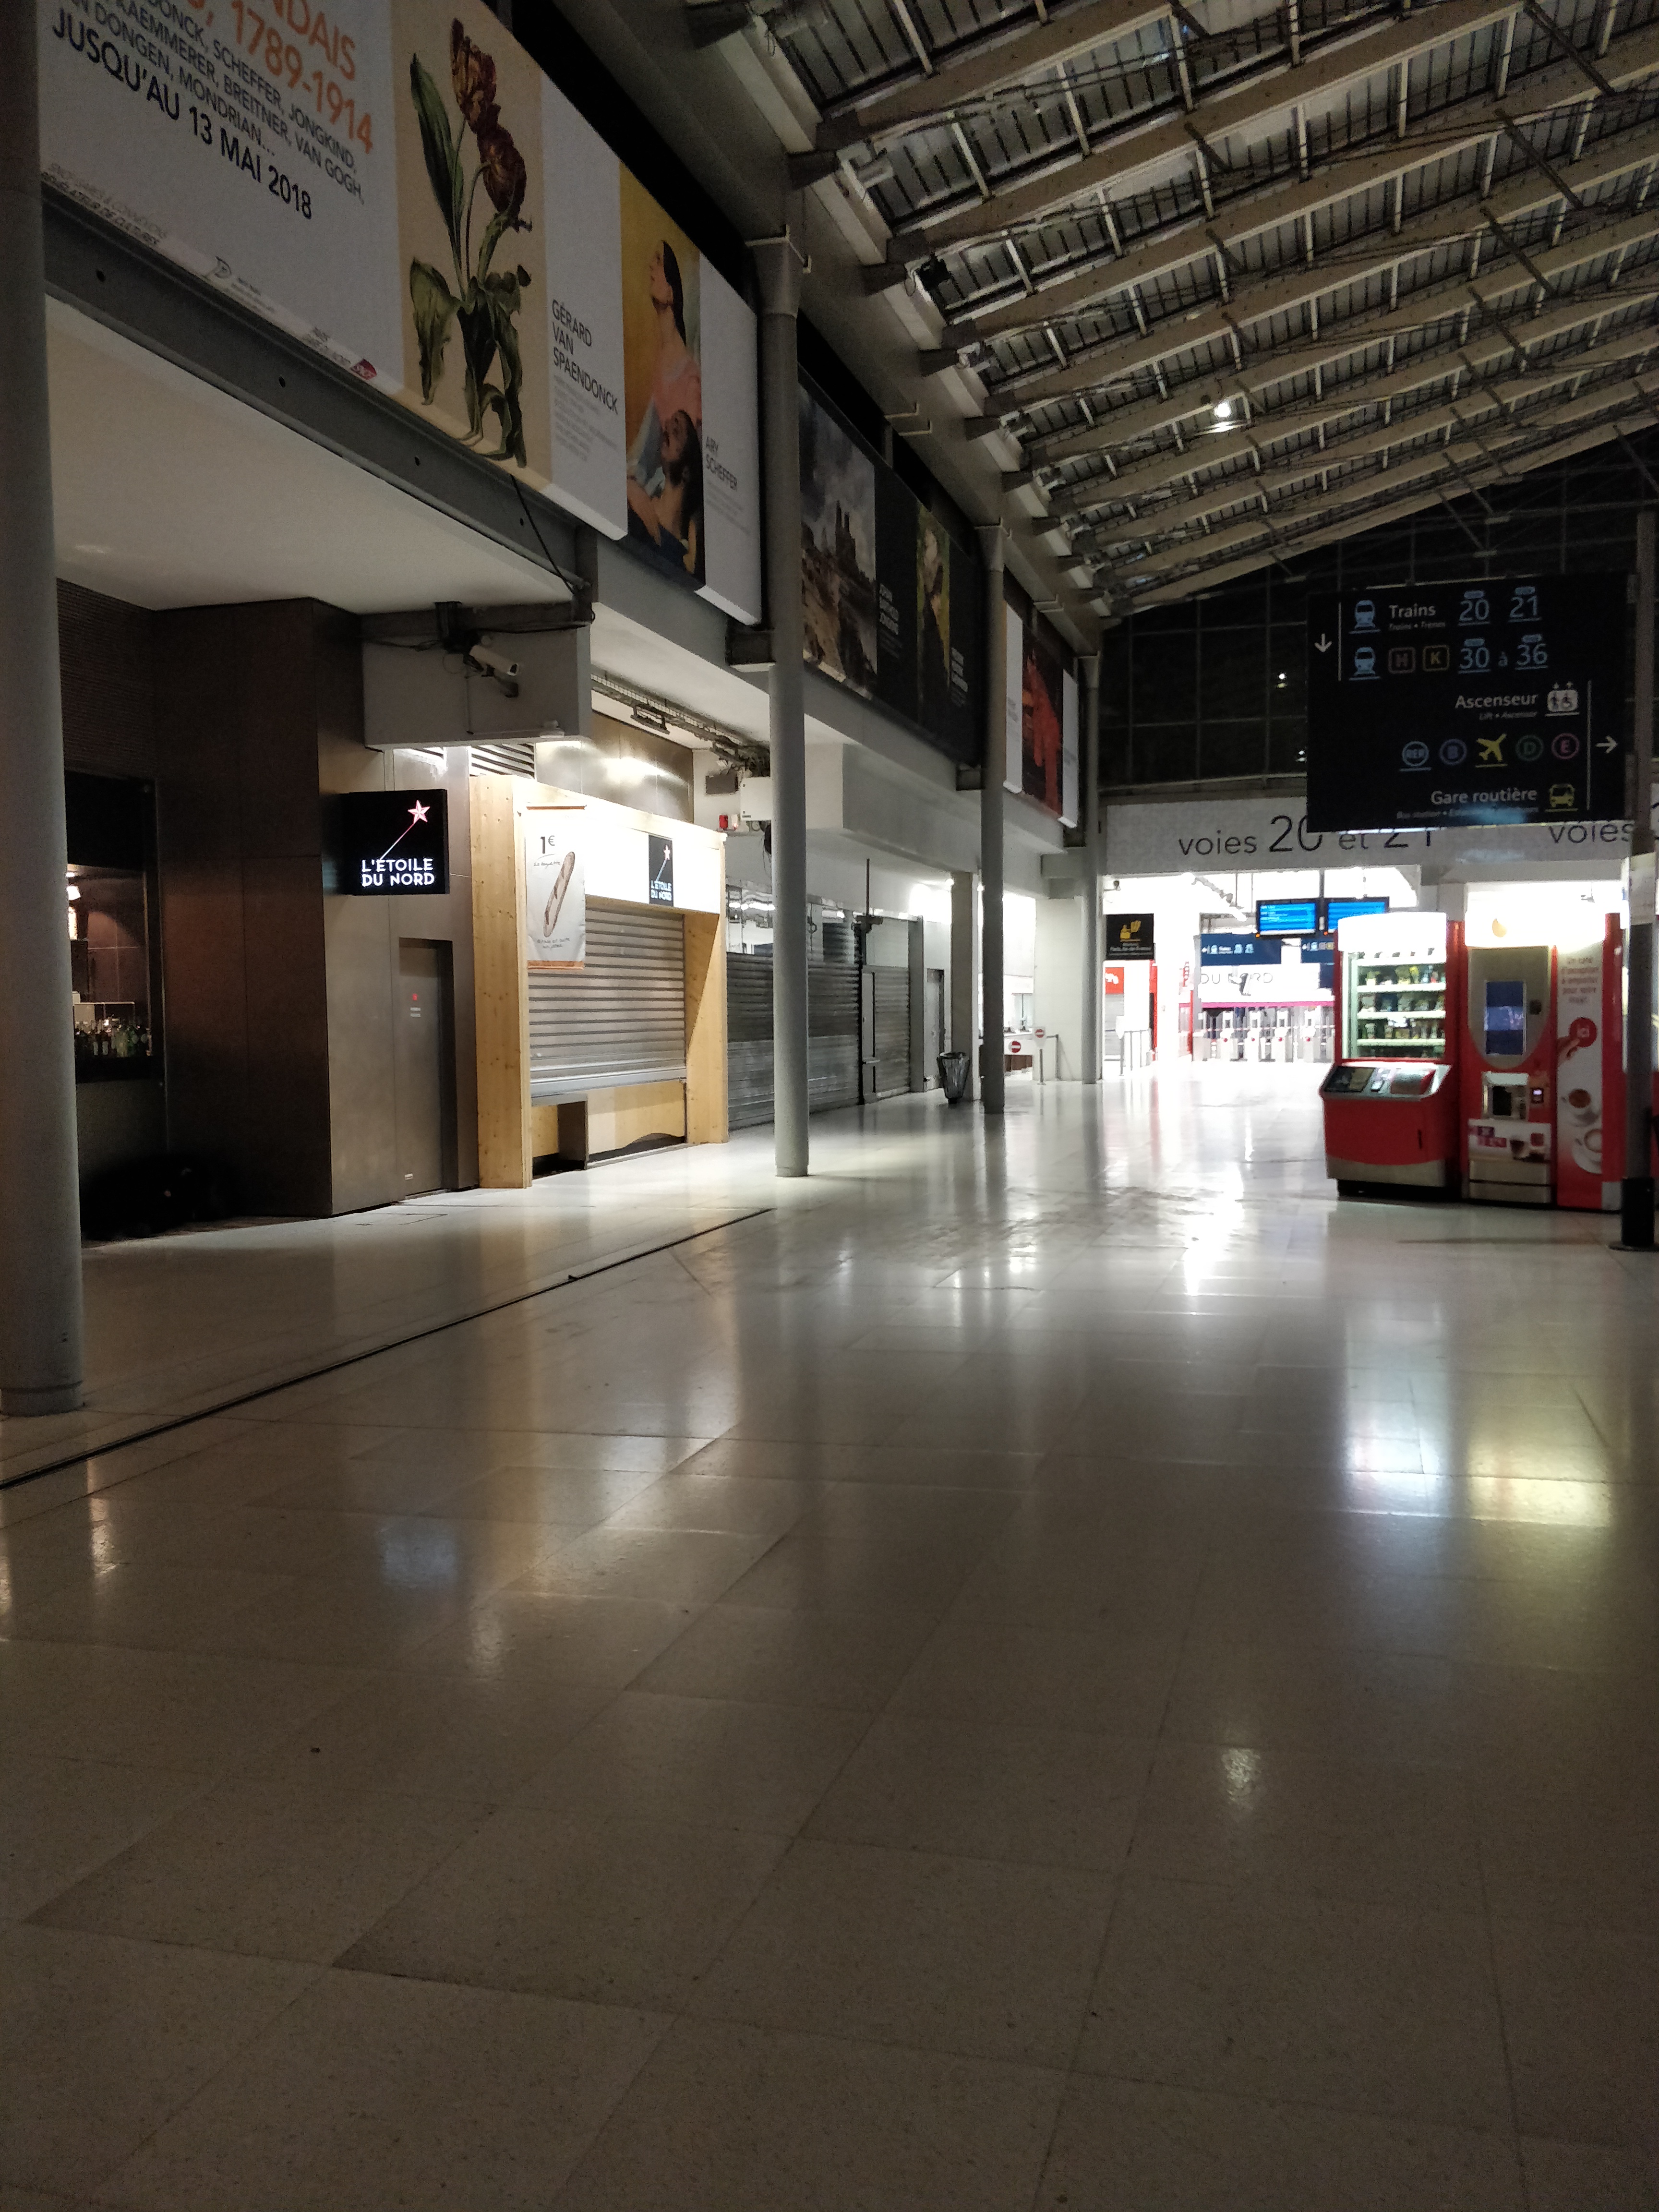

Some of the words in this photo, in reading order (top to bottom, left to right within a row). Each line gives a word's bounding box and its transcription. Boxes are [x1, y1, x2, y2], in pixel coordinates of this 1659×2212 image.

[272, 0, 356, 81] DAIS
[232, 1, 374, 155] 1789-1914
[52, 7, 180, 120] JUSQU'AU
[189, 106, 213, 145] 13
[220, 127, 261, 183] MAI
[268, 165, 312, 219] 2018
[213, 38, 284, 116] SCHEFFER,
[289, 103, 357, 175] JONGKIND,
[223, 74, 292, 146] BREITNER,
[294, 131, 322, 168] VAN
[552, 299, 592, 347] GÉRARD
[552, 321, 574, 356] VAN
[553, 346, 619, 415] SPAENDONCK
[1388, 603, 1437, 619] Trains
[1458, 599, 1490, 623] 20
[1508, 595, 1539, 619] 21
[1430, 651, 1442, 666] K
[1458, 647, 1491, 670] 30
[1498, 650, 1508, 668] à
[1516, 642, 1549, 667] 36
[1455, 694, 1539, 709] Ascenseur
[1430, 790, 1468, 805] Gare
[1472, 787, 1538, 802] routière
[1178, 830, 1257, 855] voies
[361, 873, 384, 887] DU
[390, 872, 435, 887] NORD
[651, 889, 658, 899] DU
